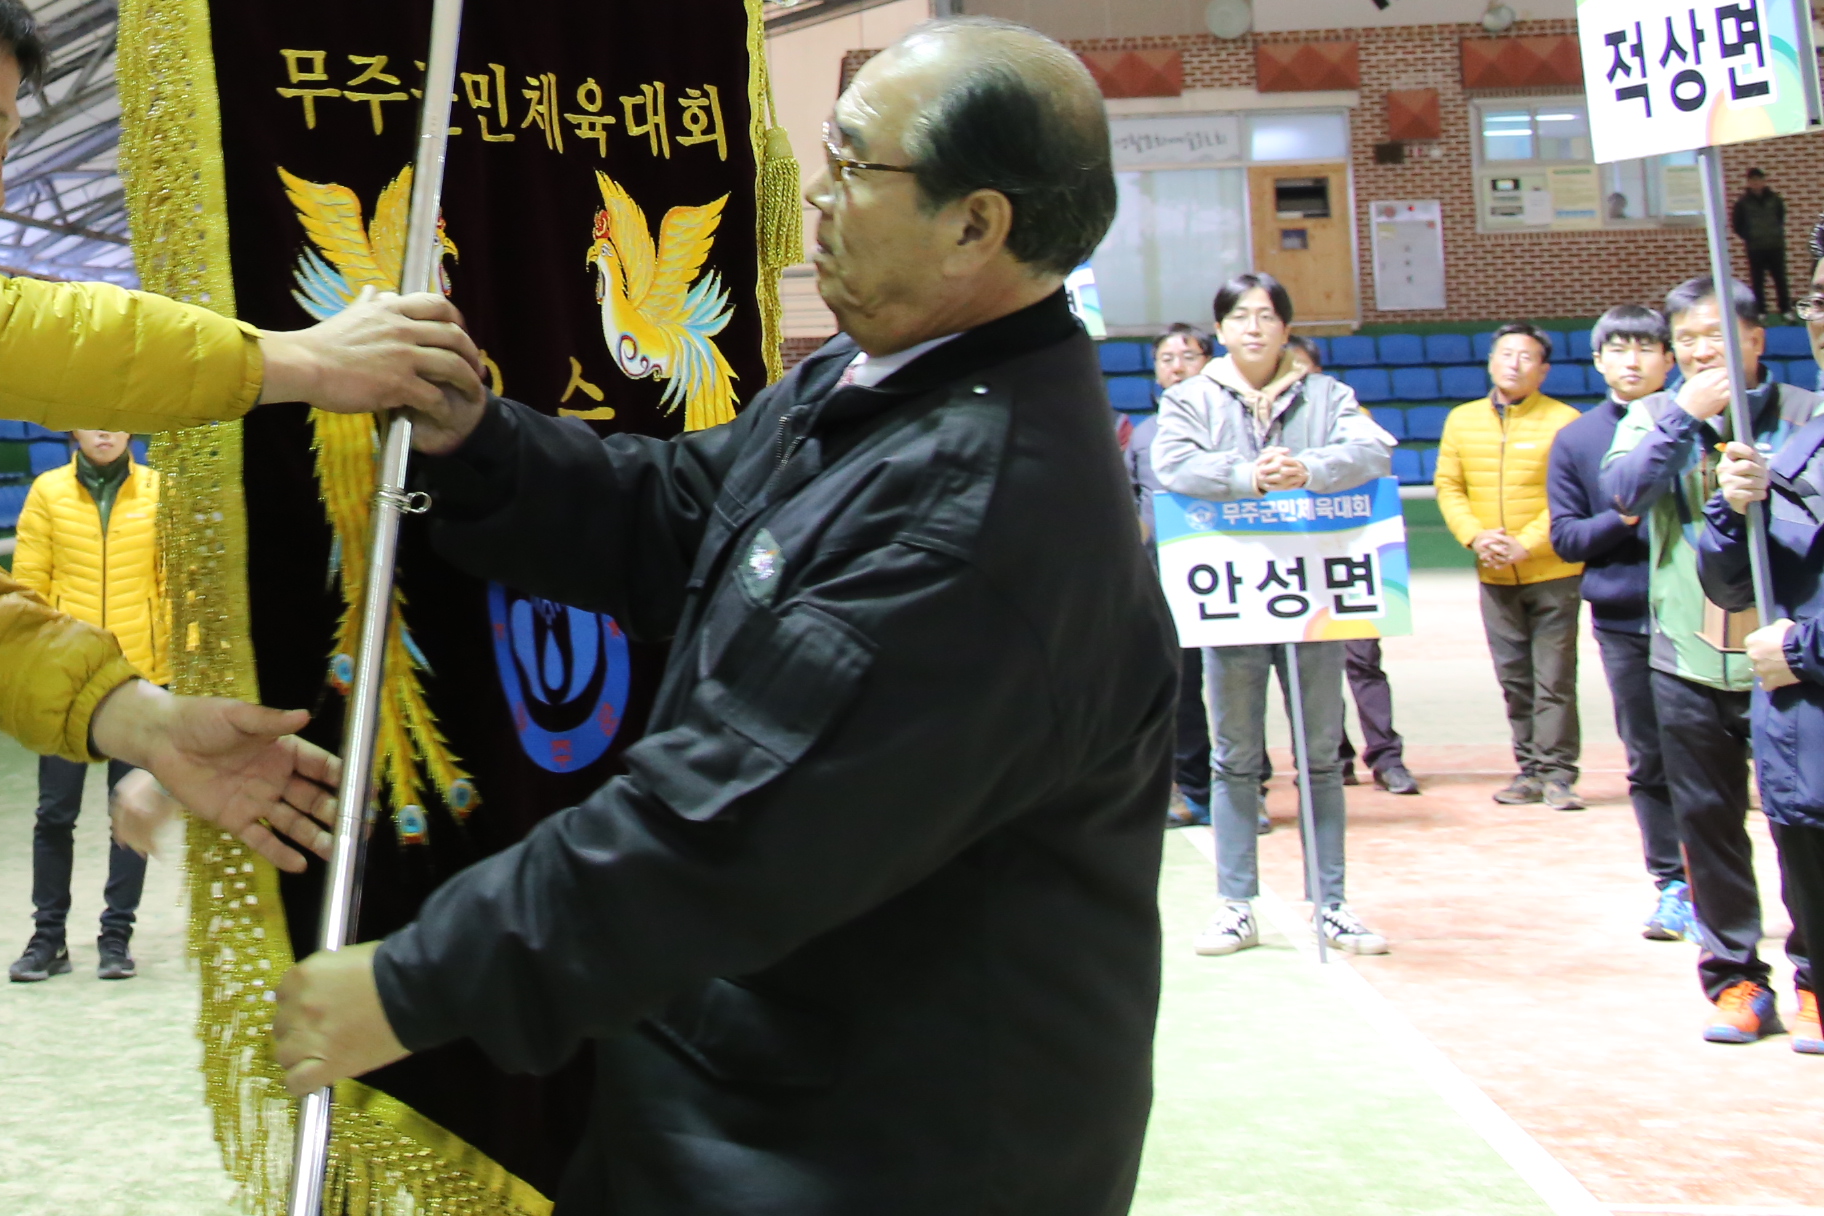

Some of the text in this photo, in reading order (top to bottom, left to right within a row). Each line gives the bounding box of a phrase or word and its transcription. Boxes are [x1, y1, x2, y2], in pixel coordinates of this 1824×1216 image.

[276, 49, 728, 161] 무주민체육대회
[1222, 494, 1371, 524] 무주군민체육대회
[1187, 553, 1378, 621] 안성면
